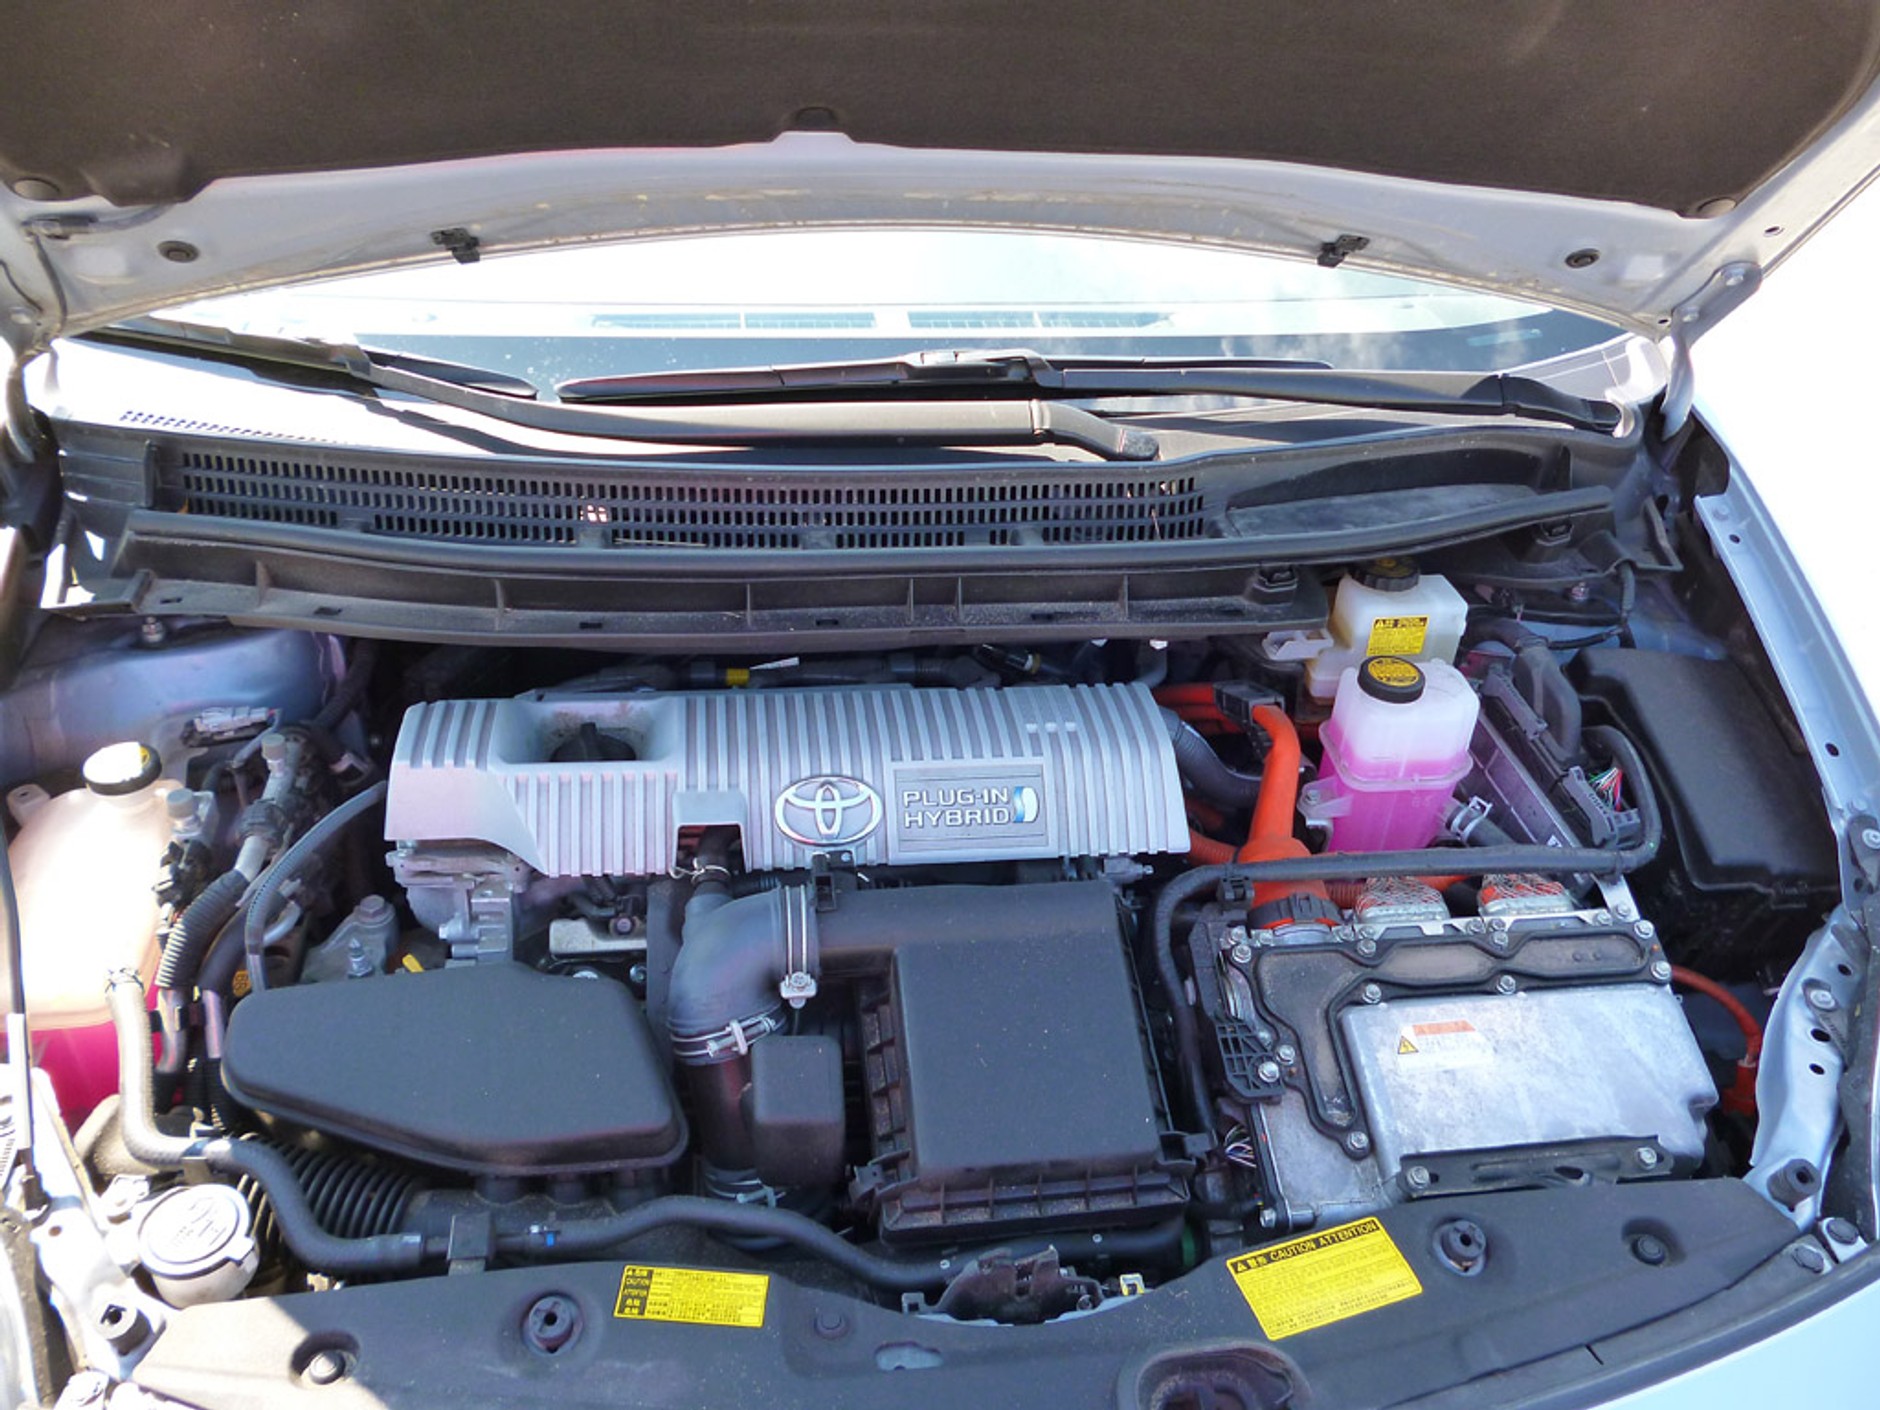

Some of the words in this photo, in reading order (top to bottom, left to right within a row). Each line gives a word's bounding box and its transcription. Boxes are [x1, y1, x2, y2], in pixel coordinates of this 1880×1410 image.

[903, 787, 1009, 807] PLUG-IN
[904, 807, 1010, 828] HYBRID
[1270, 1239, 1316, 1260] CAUTION
[1318, 1221, 1378, 1246] ATTENTION
